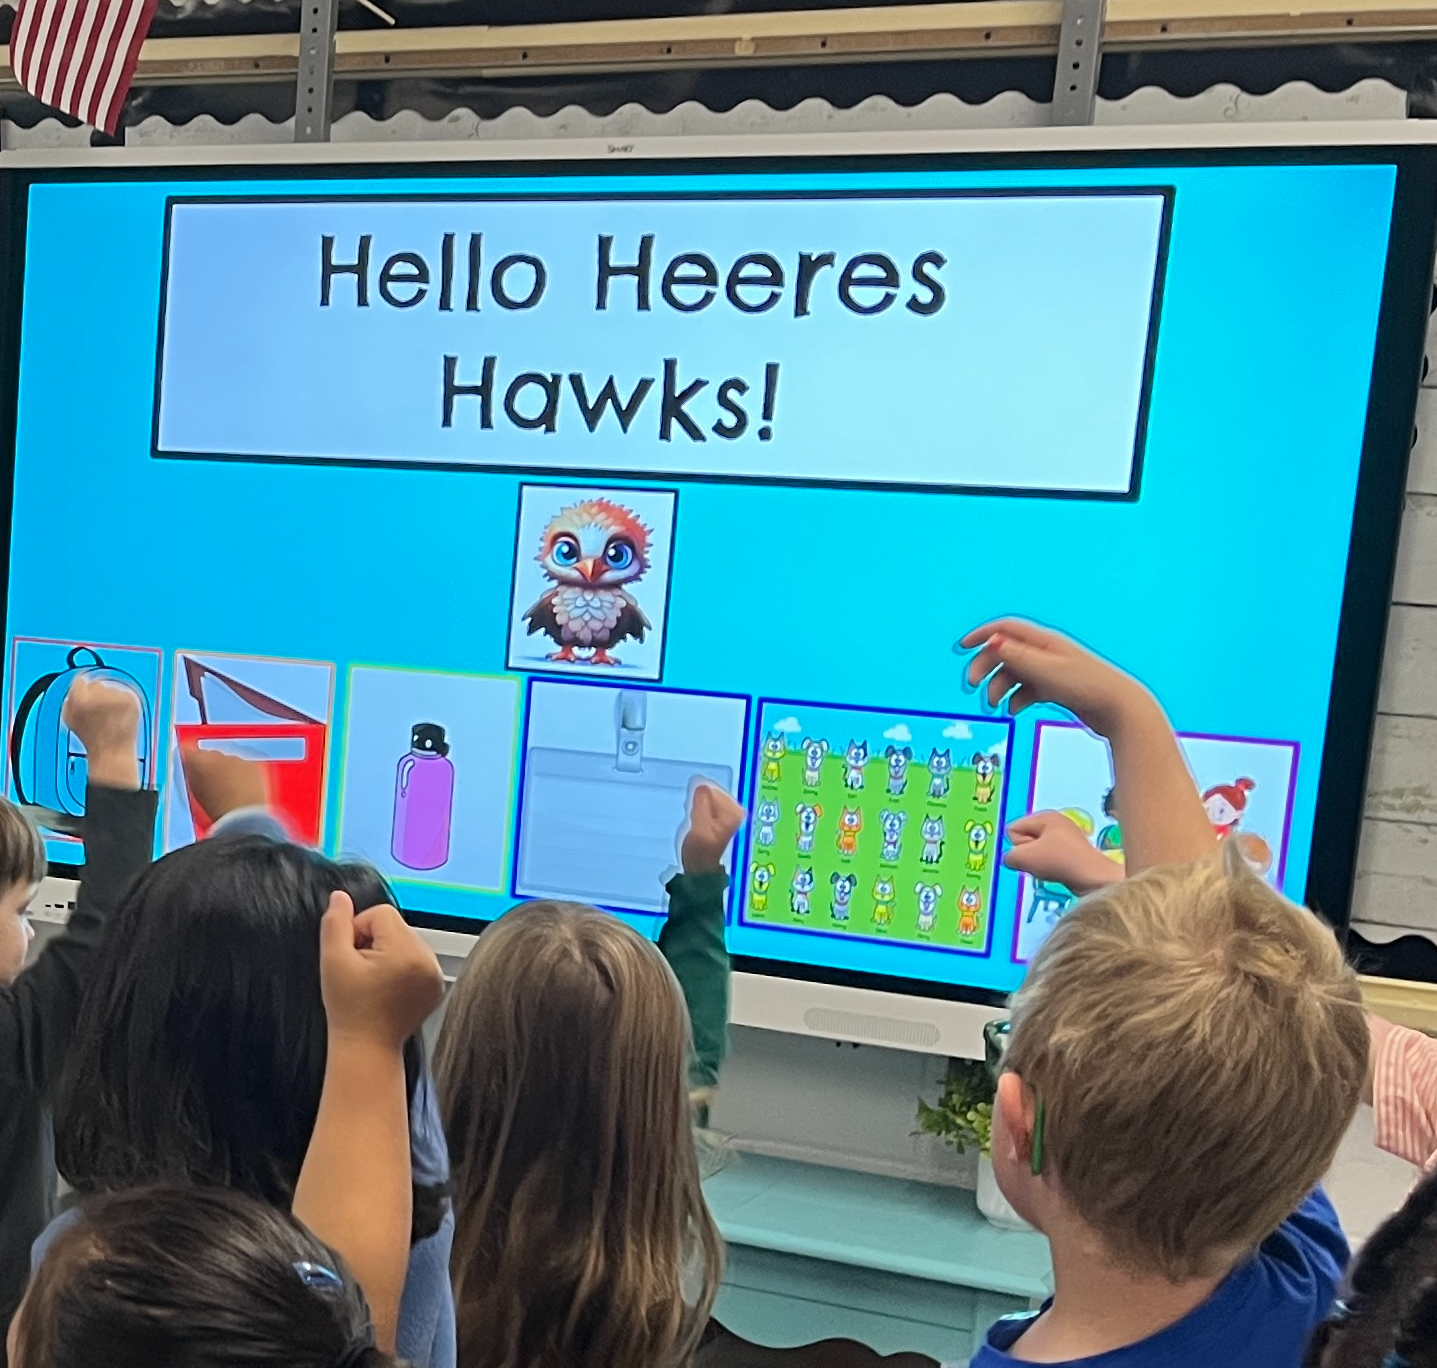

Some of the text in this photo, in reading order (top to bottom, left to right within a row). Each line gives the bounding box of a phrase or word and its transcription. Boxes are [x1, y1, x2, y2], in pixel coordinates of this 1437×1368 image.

[319, 232, 948, 319] Hello Heeres
[440, 354, 780, 443] Hawks!
